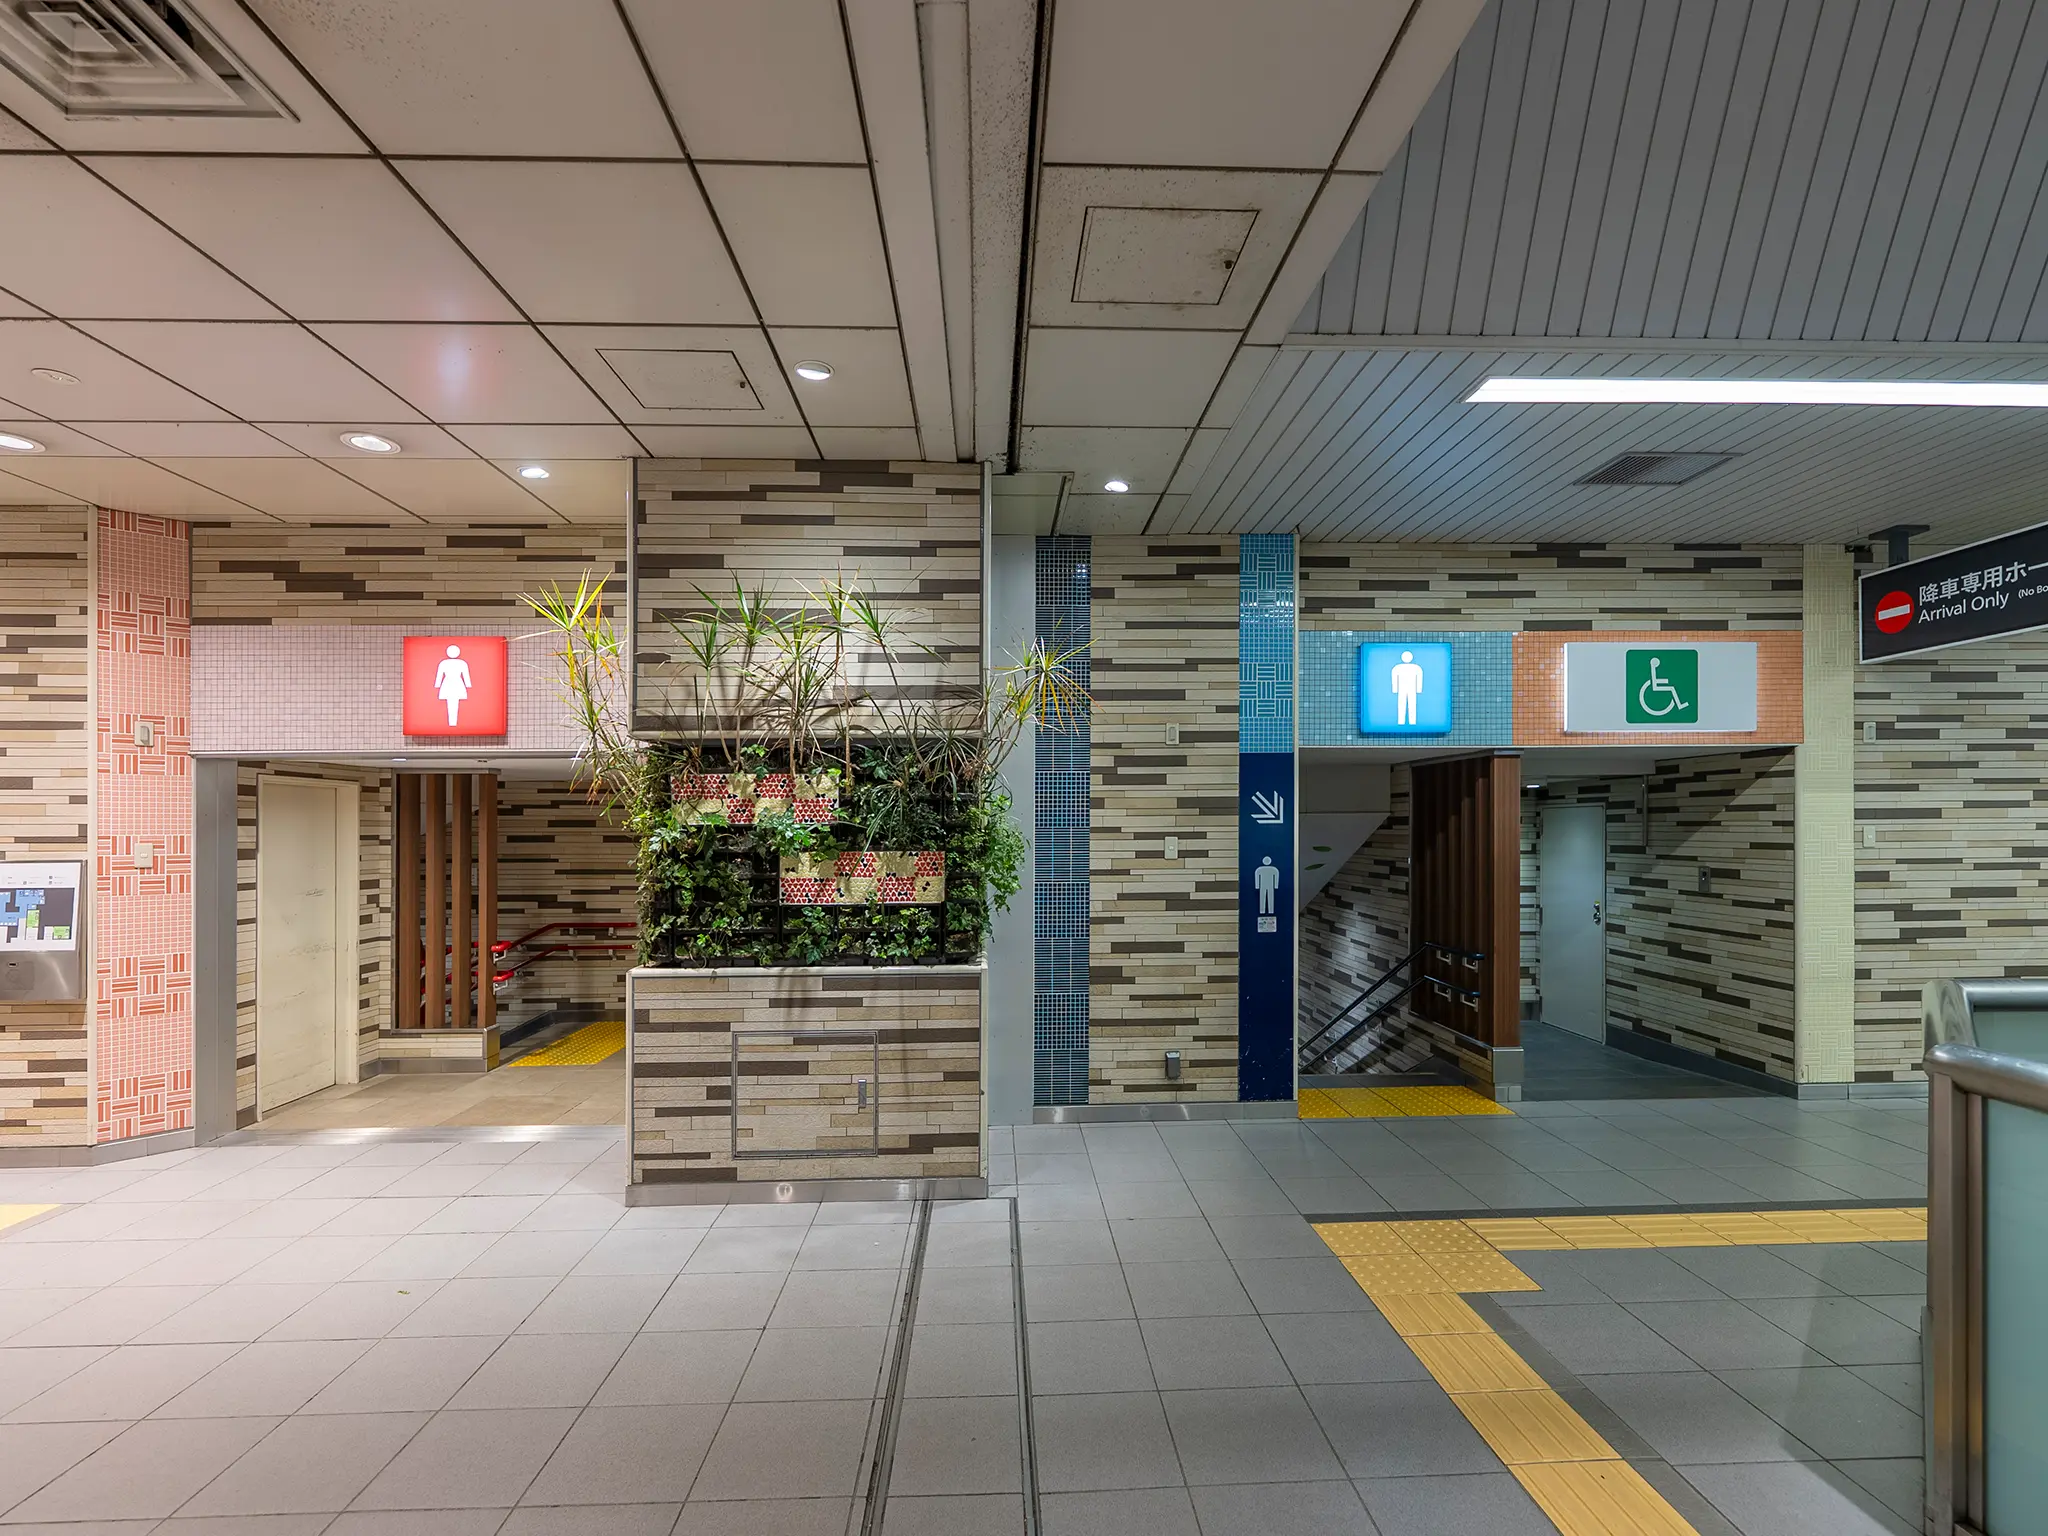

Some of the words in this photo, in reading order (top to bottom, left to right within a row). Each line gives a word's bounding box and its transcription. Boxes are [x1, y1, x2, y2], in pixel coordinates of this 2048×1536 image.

[1918, 599, 1967, 624] Arrival
[1971, 591, 2010, 612] Only
[2018, 588, 2035, 599] (No
